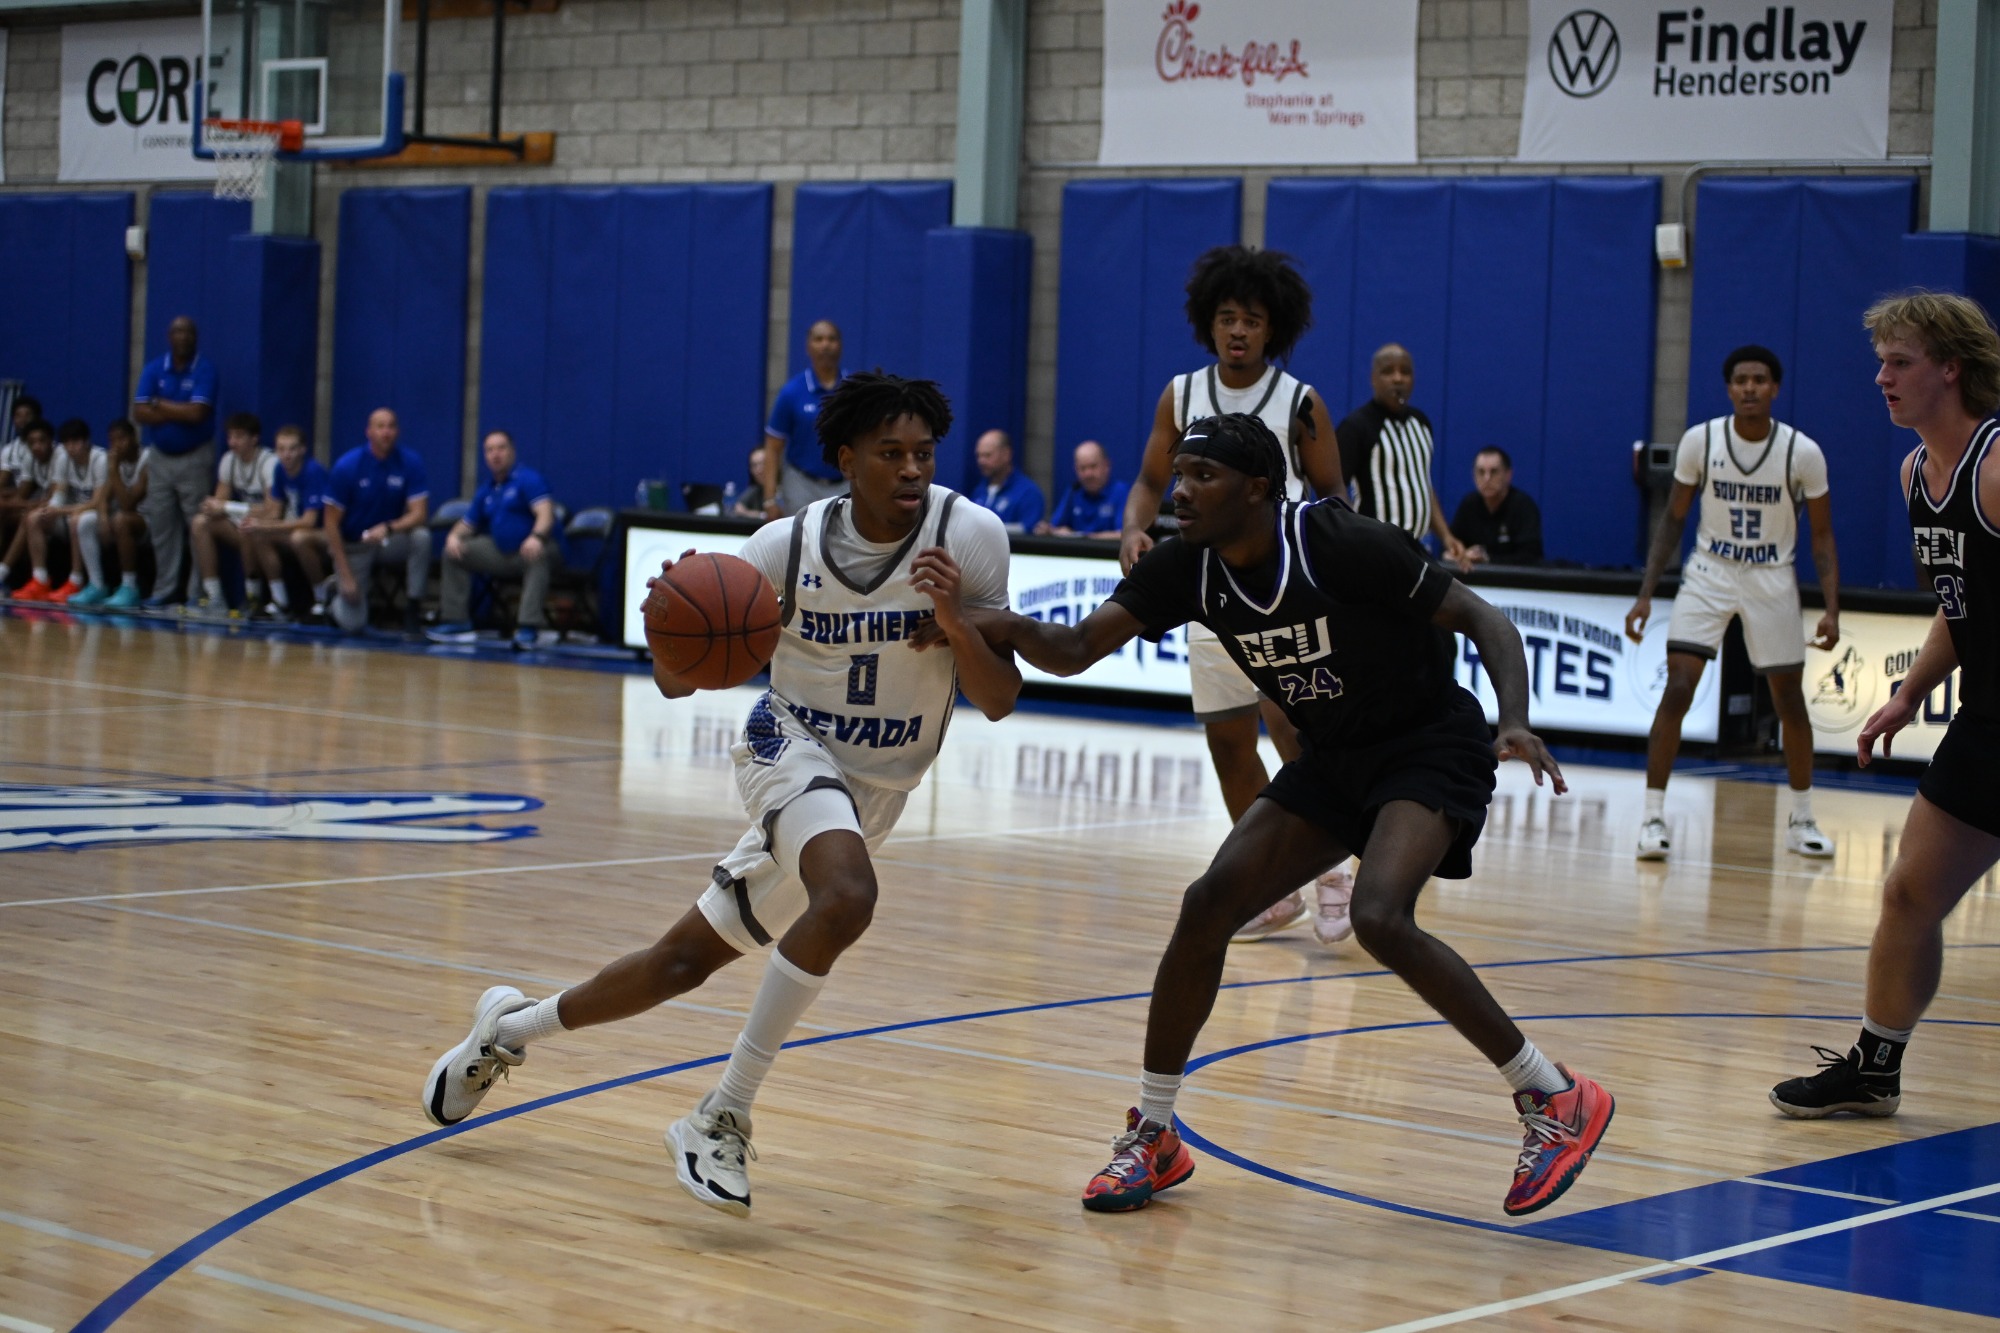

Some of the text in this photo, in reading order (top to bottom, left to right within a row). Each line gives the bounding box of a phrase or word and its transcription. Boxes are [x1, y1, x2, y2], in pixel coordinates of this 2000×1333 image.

[1156, 17, 1309, 87] Chick-fil-A
[1656, 6, 1867, 76] Findlay
[1653, 64, 1830, 97] Henderson
[1245, 93, 1334, 109] Stephanie at
[1268, 111, 1366, 128] Warm Springs
[1712, 480, 1782, 504] SOUTHERN
[1729, 507, 1762, 540] 22
[1709, 537, 1778, 564] NEVADA
[1234, 616, 1332, 668] GCU
[846, 653, 880, 706] 0
[1278, 667, 1344, 706] 24
